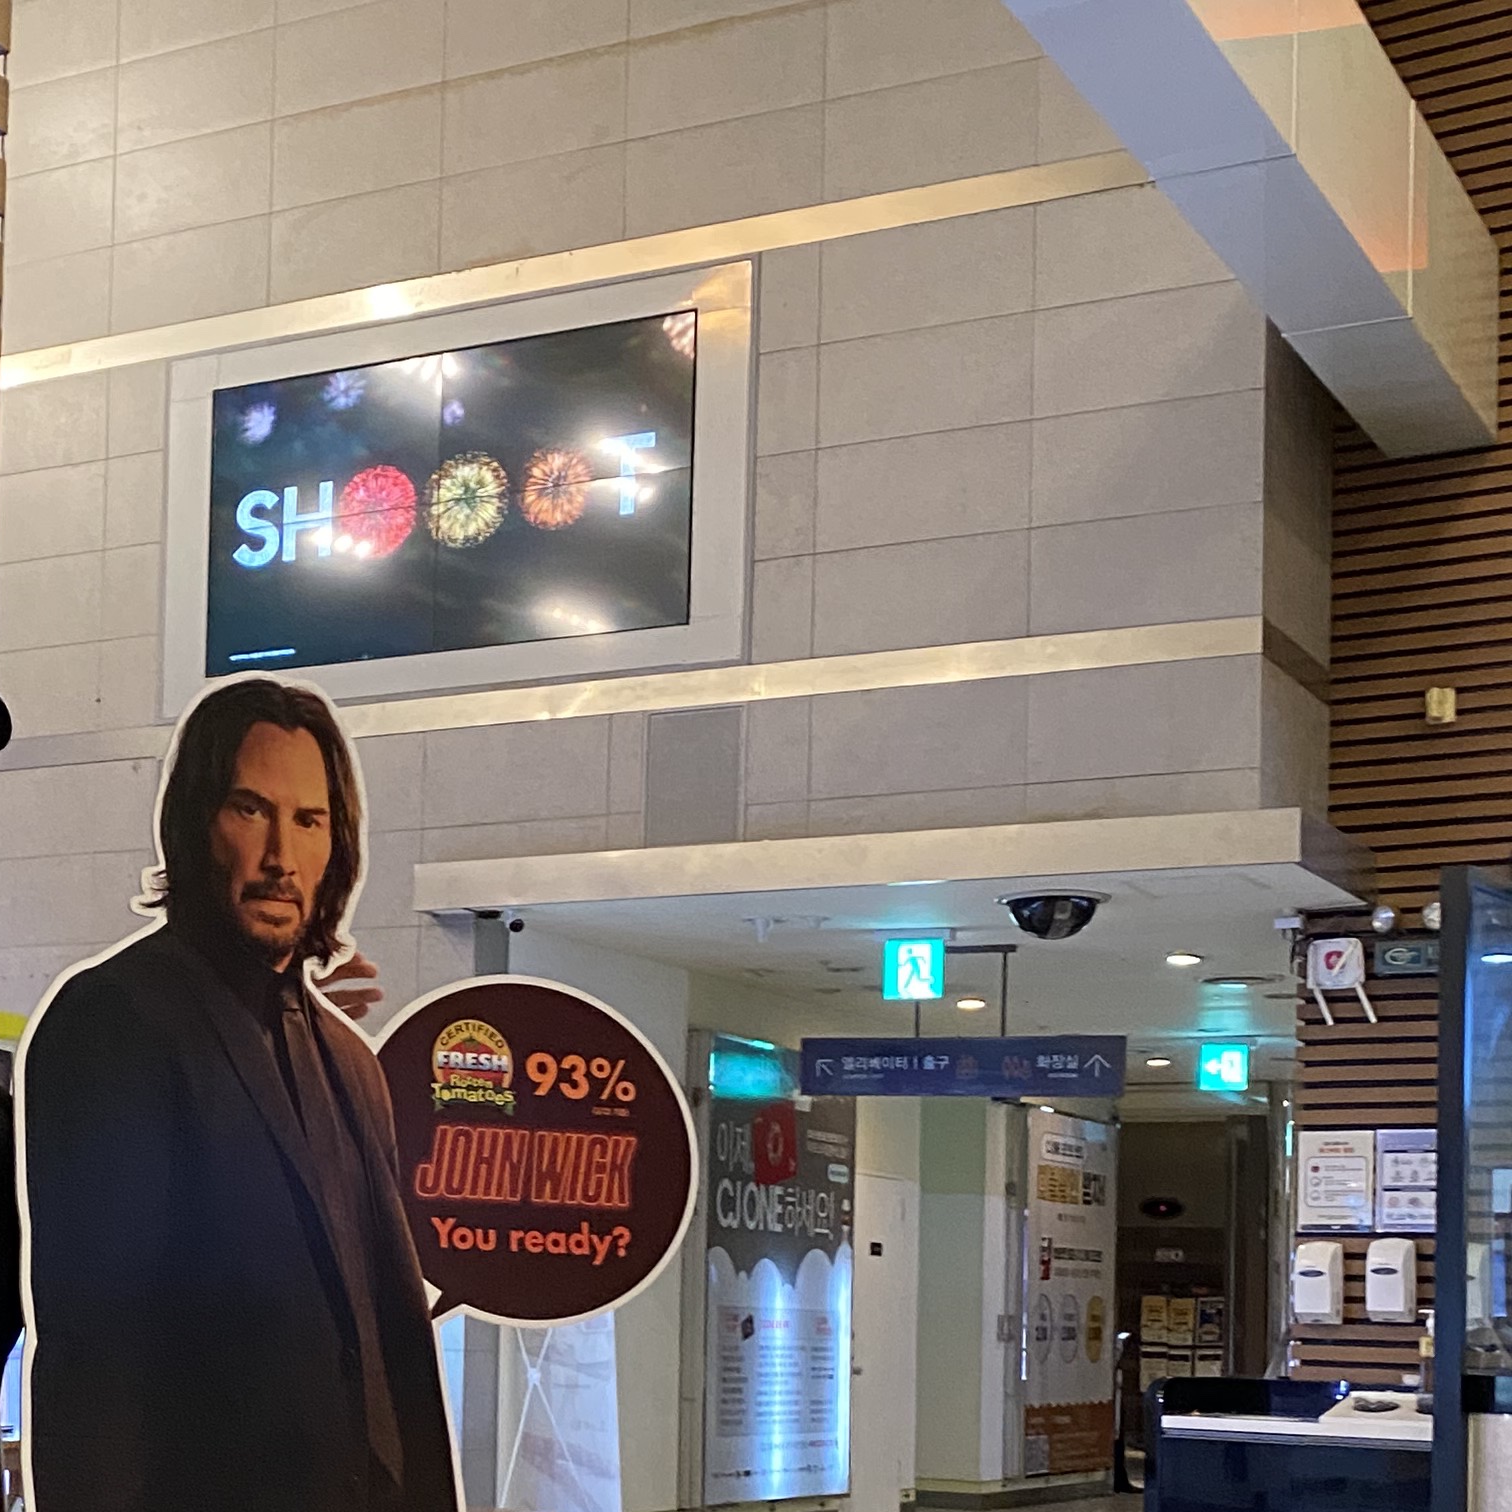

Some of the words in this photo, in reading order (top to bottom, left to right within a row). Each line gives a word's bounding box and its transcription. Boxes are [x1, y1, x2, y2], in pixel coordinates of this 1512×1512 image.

[440, 1022, 505, 1049] CERTIFIED
[436, 1051, 509, 1073] FRESH
[841, 1055, 909, 1071] 엘리베이터
[923, 1054, 950, 1071] 출구
[1036, 1054, 1080, 1070] 화장실
[525, 1052, 637, 1102] 93%
[431, 1082, 515, 1106] Tomatoes
[415, 1126, 530, 1202] JOHN
[531, 1131, 638, 1207] WICK
[431, 1216, 497, 1251] You
[509, 1221, 632, 1266] ready?
